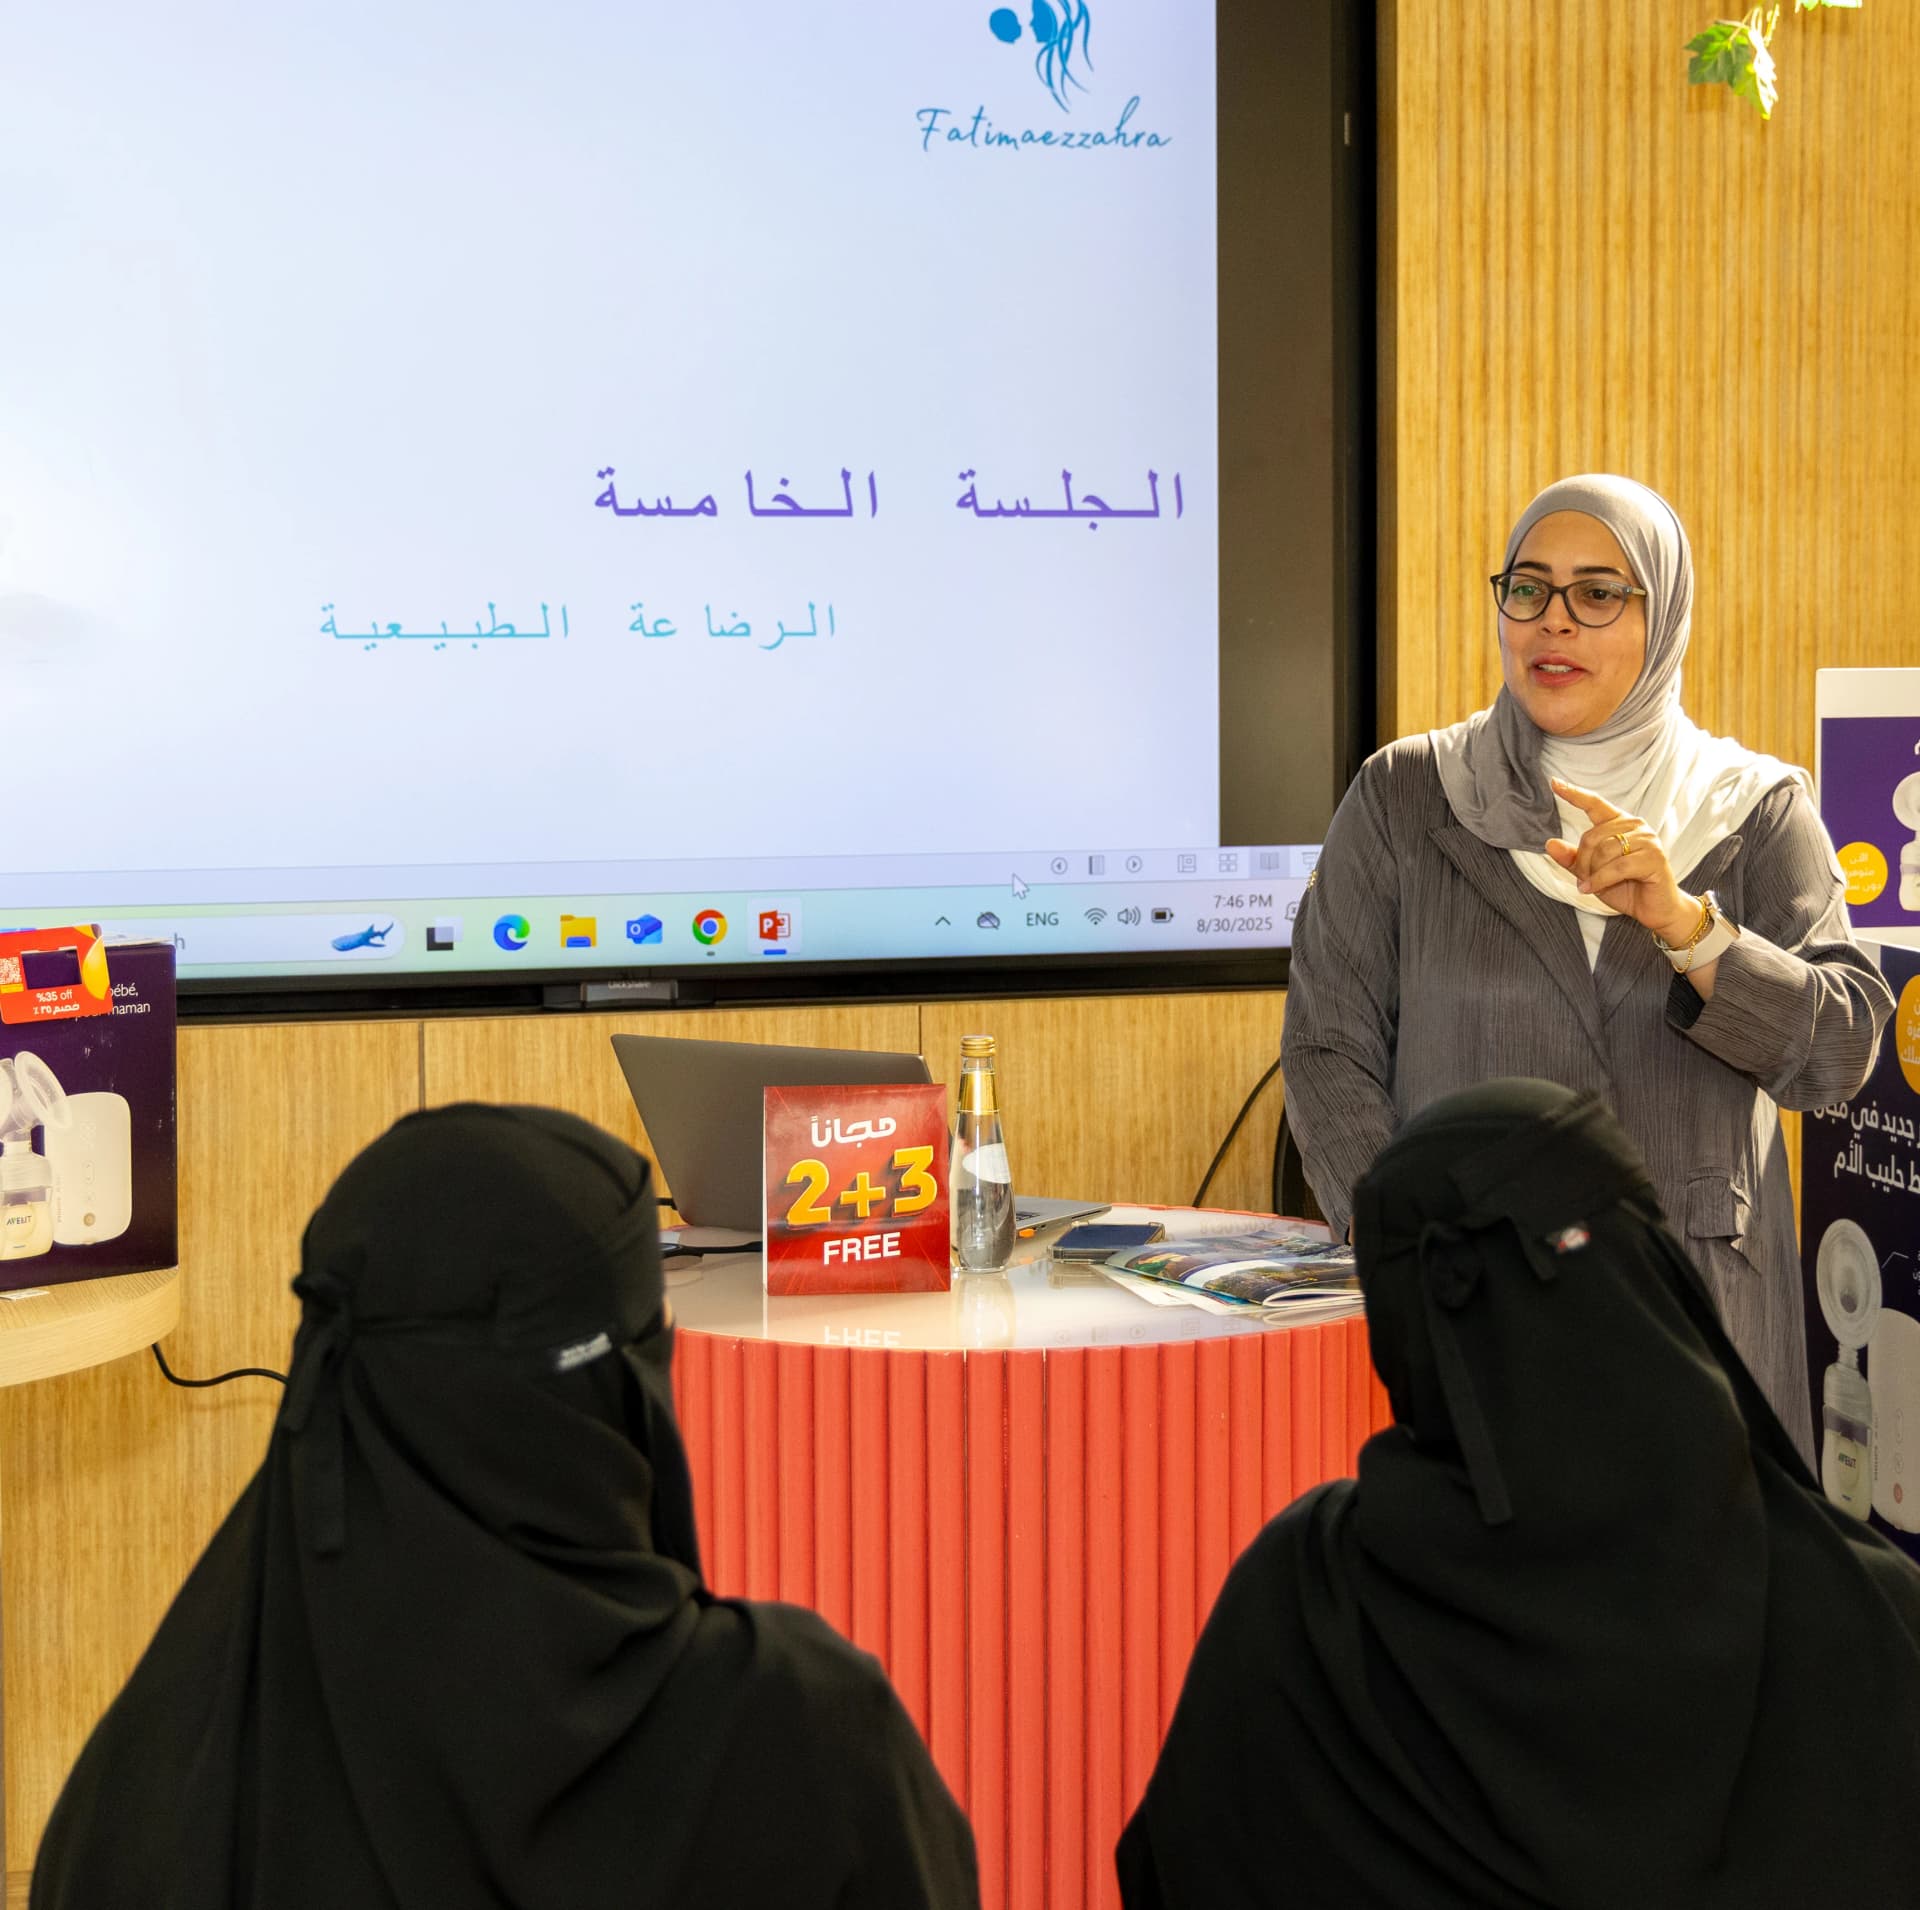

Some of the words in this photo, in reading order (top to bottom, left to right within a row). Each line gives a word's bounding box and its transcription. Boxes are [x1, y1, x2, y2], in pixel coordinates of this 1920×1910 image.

[916, 95, 1173, 152] Fatimaezzahra
[956, 469, 1183, 531] الجلسة
[320, 602, 568, 651] الطبيعية
[1026, 911, 1060, 927] ENG
[1214, 895, 1244, 908] 7:46
[1249, 894, 1273, 907] PM
[1197, 917, 1273, 933] 8/30/2025
[60, 988, 73, 1000] off
[1851, 1100, 1879, 1139] في
[1881, 1112, 1915, 1147] جديد
[1834, 1139, 1863, 1178] الأم
[1865, 1154, 1905, 1193] حليب
[823, 1232, 901, 1265] FREE
